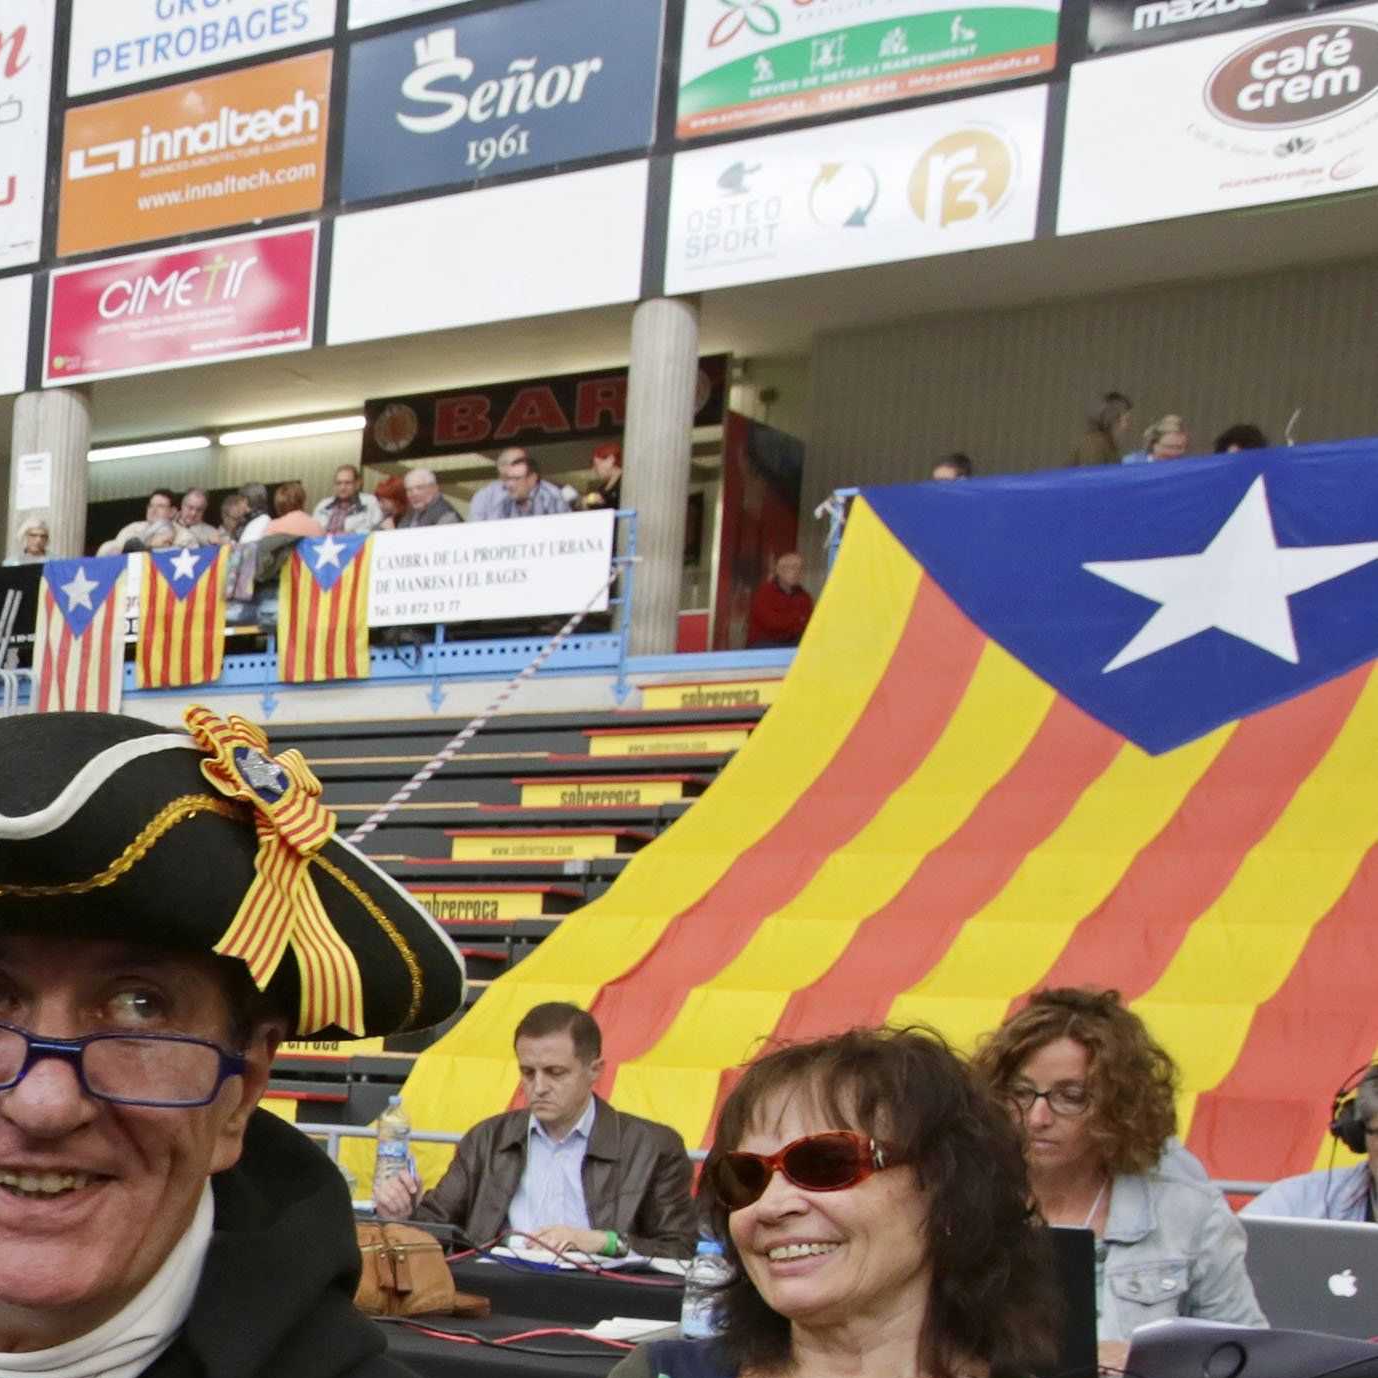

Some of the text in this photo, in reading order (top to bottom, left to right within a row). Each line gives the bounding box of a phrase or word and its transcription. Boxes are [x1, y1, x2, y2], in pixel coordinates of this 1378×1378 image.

[91, 1, 309, 78] PETROBAGES
[1251, 28, 1354, 80] café
[396, 55, 603, 133] Señor
[1237, 65, 1361, 111] crem
[140, 89, 320, 166] innaltech
[466, 123, 530, 171] 1961
[137, 162, 317, 210] www.innaltech.com
[686, 197, 782, 234] OSTEO
[685, 224, 778, 259] SPORT
[432, 377, 628, 447] BAR
[375, 537, 604, 571] CAMBRA DE LA PROPIETAT URBANA
[375, 579, 393, 595] DE
[394, 575, 454, 594] MANRESA
[464, 573, 481, 588] EL
[484, 569, 528, 587] BAGES
